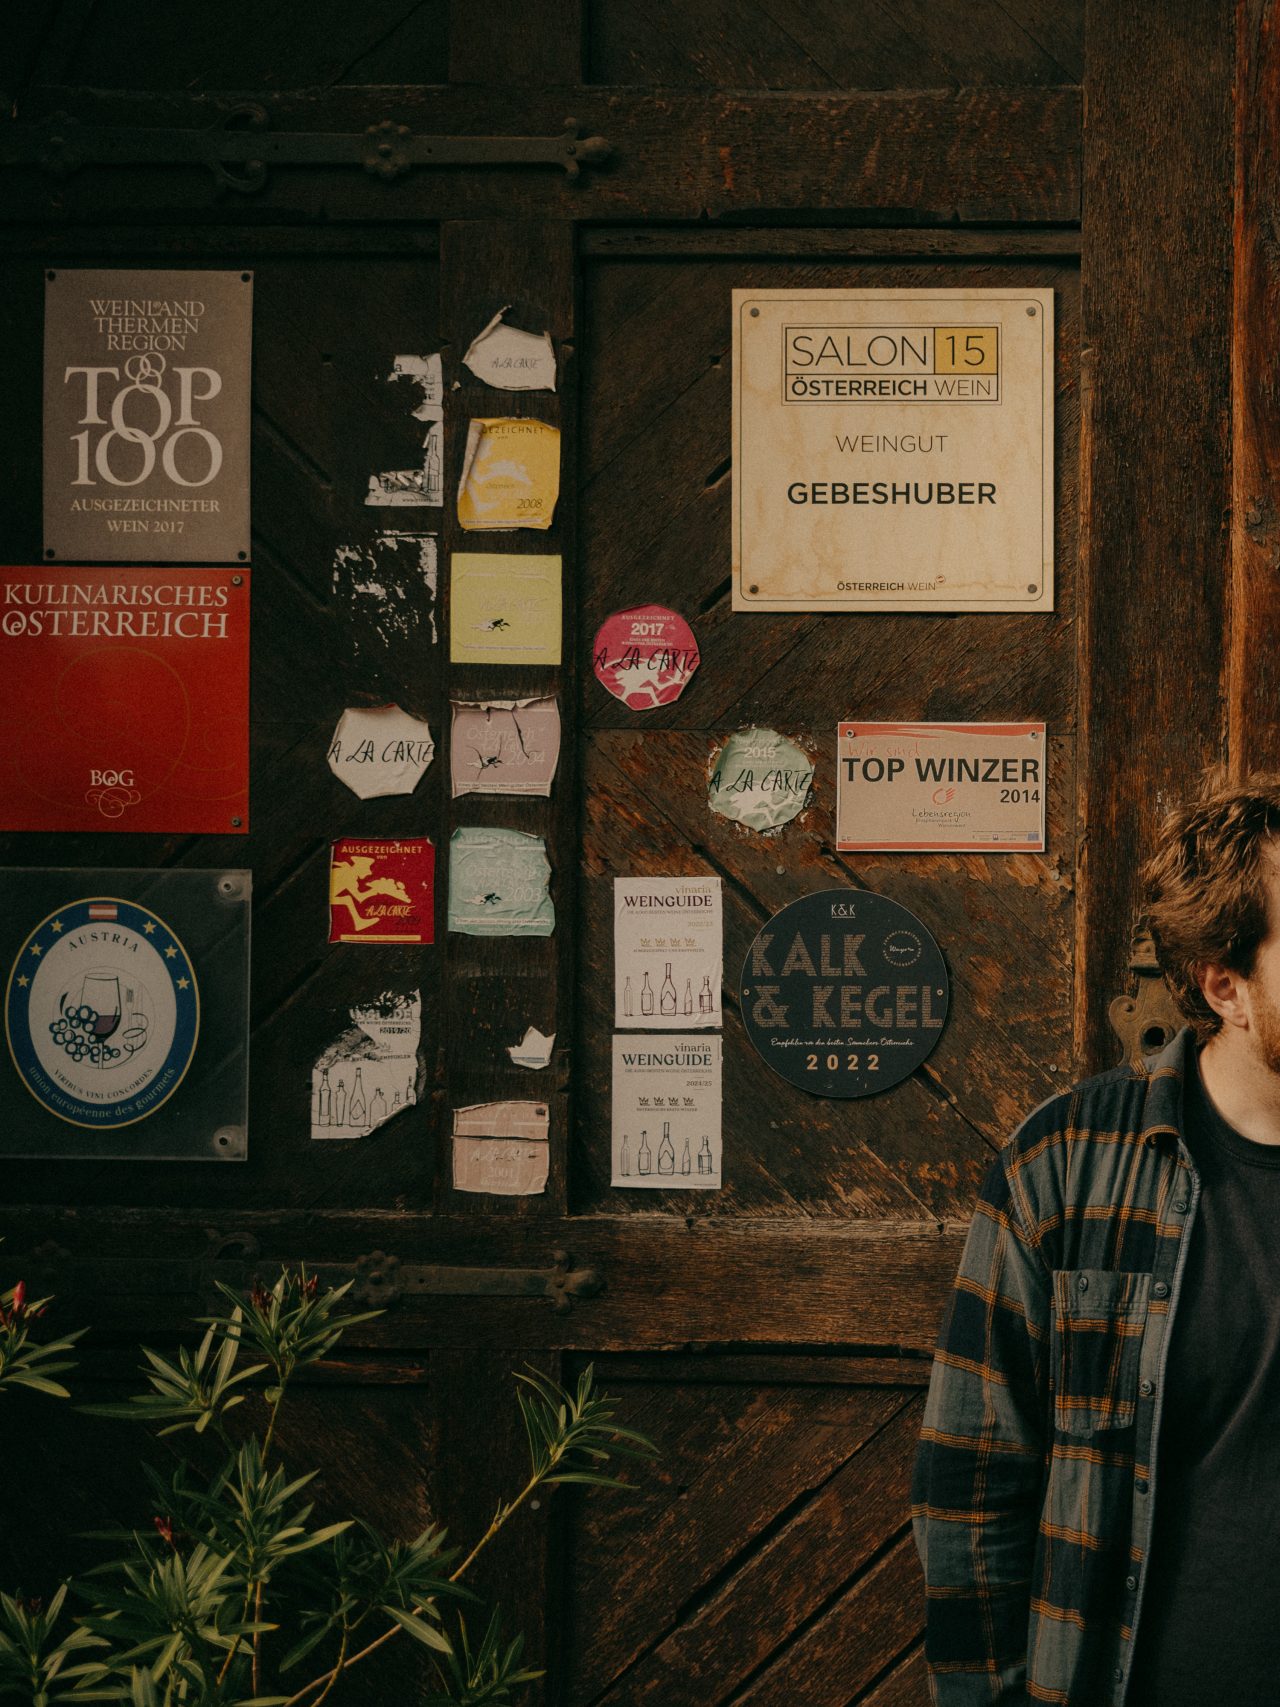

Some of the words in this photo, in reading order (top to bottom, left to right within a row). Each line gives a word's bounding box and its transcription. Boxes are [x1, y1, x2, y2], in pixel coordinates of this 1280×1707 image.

[90, 300, 205, 317] WEINLAND
[94, 317, 199, 334] THERMEN
[107, 334, 187, 351] REGION
[791, 335, 927, 367] SALON
[945, 335, 986, 367] 15
[791, 376, 927, 396] ÖSTERREICH
[934, 379, 991, 396] WEIN
[64, 366, 222, 443] TOP
[835, 435, 949, 453] WEINGUT
[69, 427, 223, 487] 100
[787, 482, 997, 505] GEBESHUBER
[71, 500, 220, 513] AUSGEZEICHNETER
[517, 498, 543, 509] 2008
[107, 520, 149, 533] WEIN
[153, 521, 185, 534] 2017
[837, 580, 904, 591] ÖSTERREICH
[907, 582, 936, 591] WEIN
[4, 584, 229, 607] KULINARISCHES
[631, 622, 665, 636] 2017
[593, 647, 609, 671] A
[612, 647, 641, 671] LA
[647, 647, 700, 675] CARTE
[328, 741, 341, 763] A
[346, 739, 375, 763] LA
[382, 740, 435, 767] CARTE
[744, 746, 776, 759] 2015
[842, 757, 905, 782] TOP
[915, 758, 1040, 783] WINZER
[708, 771, 721, 794] A
[726, 768, 755, 793] LA
[760, 769, 812, 795] CARTE
[1000, 789, 1040, 804] 2014
[911, 808, 972, 823] Lebensregion
[341, 846, 422, 854] AUSGEZEICHNET
[676, 885, 712, 894] vinaria
[624, 895, 713, 907] WEINGUIDE
[831, 904, 856, 916] K&K
[68, 932, 140, 953] AUSTRIA
[752, 931, 867, 976] KALK
[752, 985, 790, 1028] &
[812, 985, 944, 1028] KEGEL
[674, 1043, 711, 1052] vinaria
[622, 1054, 713, 1066] WEINGUIDE
[806, 1054, 880, 1070] 2022
[29, 1066, 50, 1095] union
[51, 1092, 112, 1118] européenne
[115, 1103, 135, 1117] des
[136, 1066, 177, 1110] gourmets
[53, 1068, 83, 1096] VIRIBUS
[86, 1090, 104, 1099] VINI
[107, 1068, 154, 1099] CONCORDES
